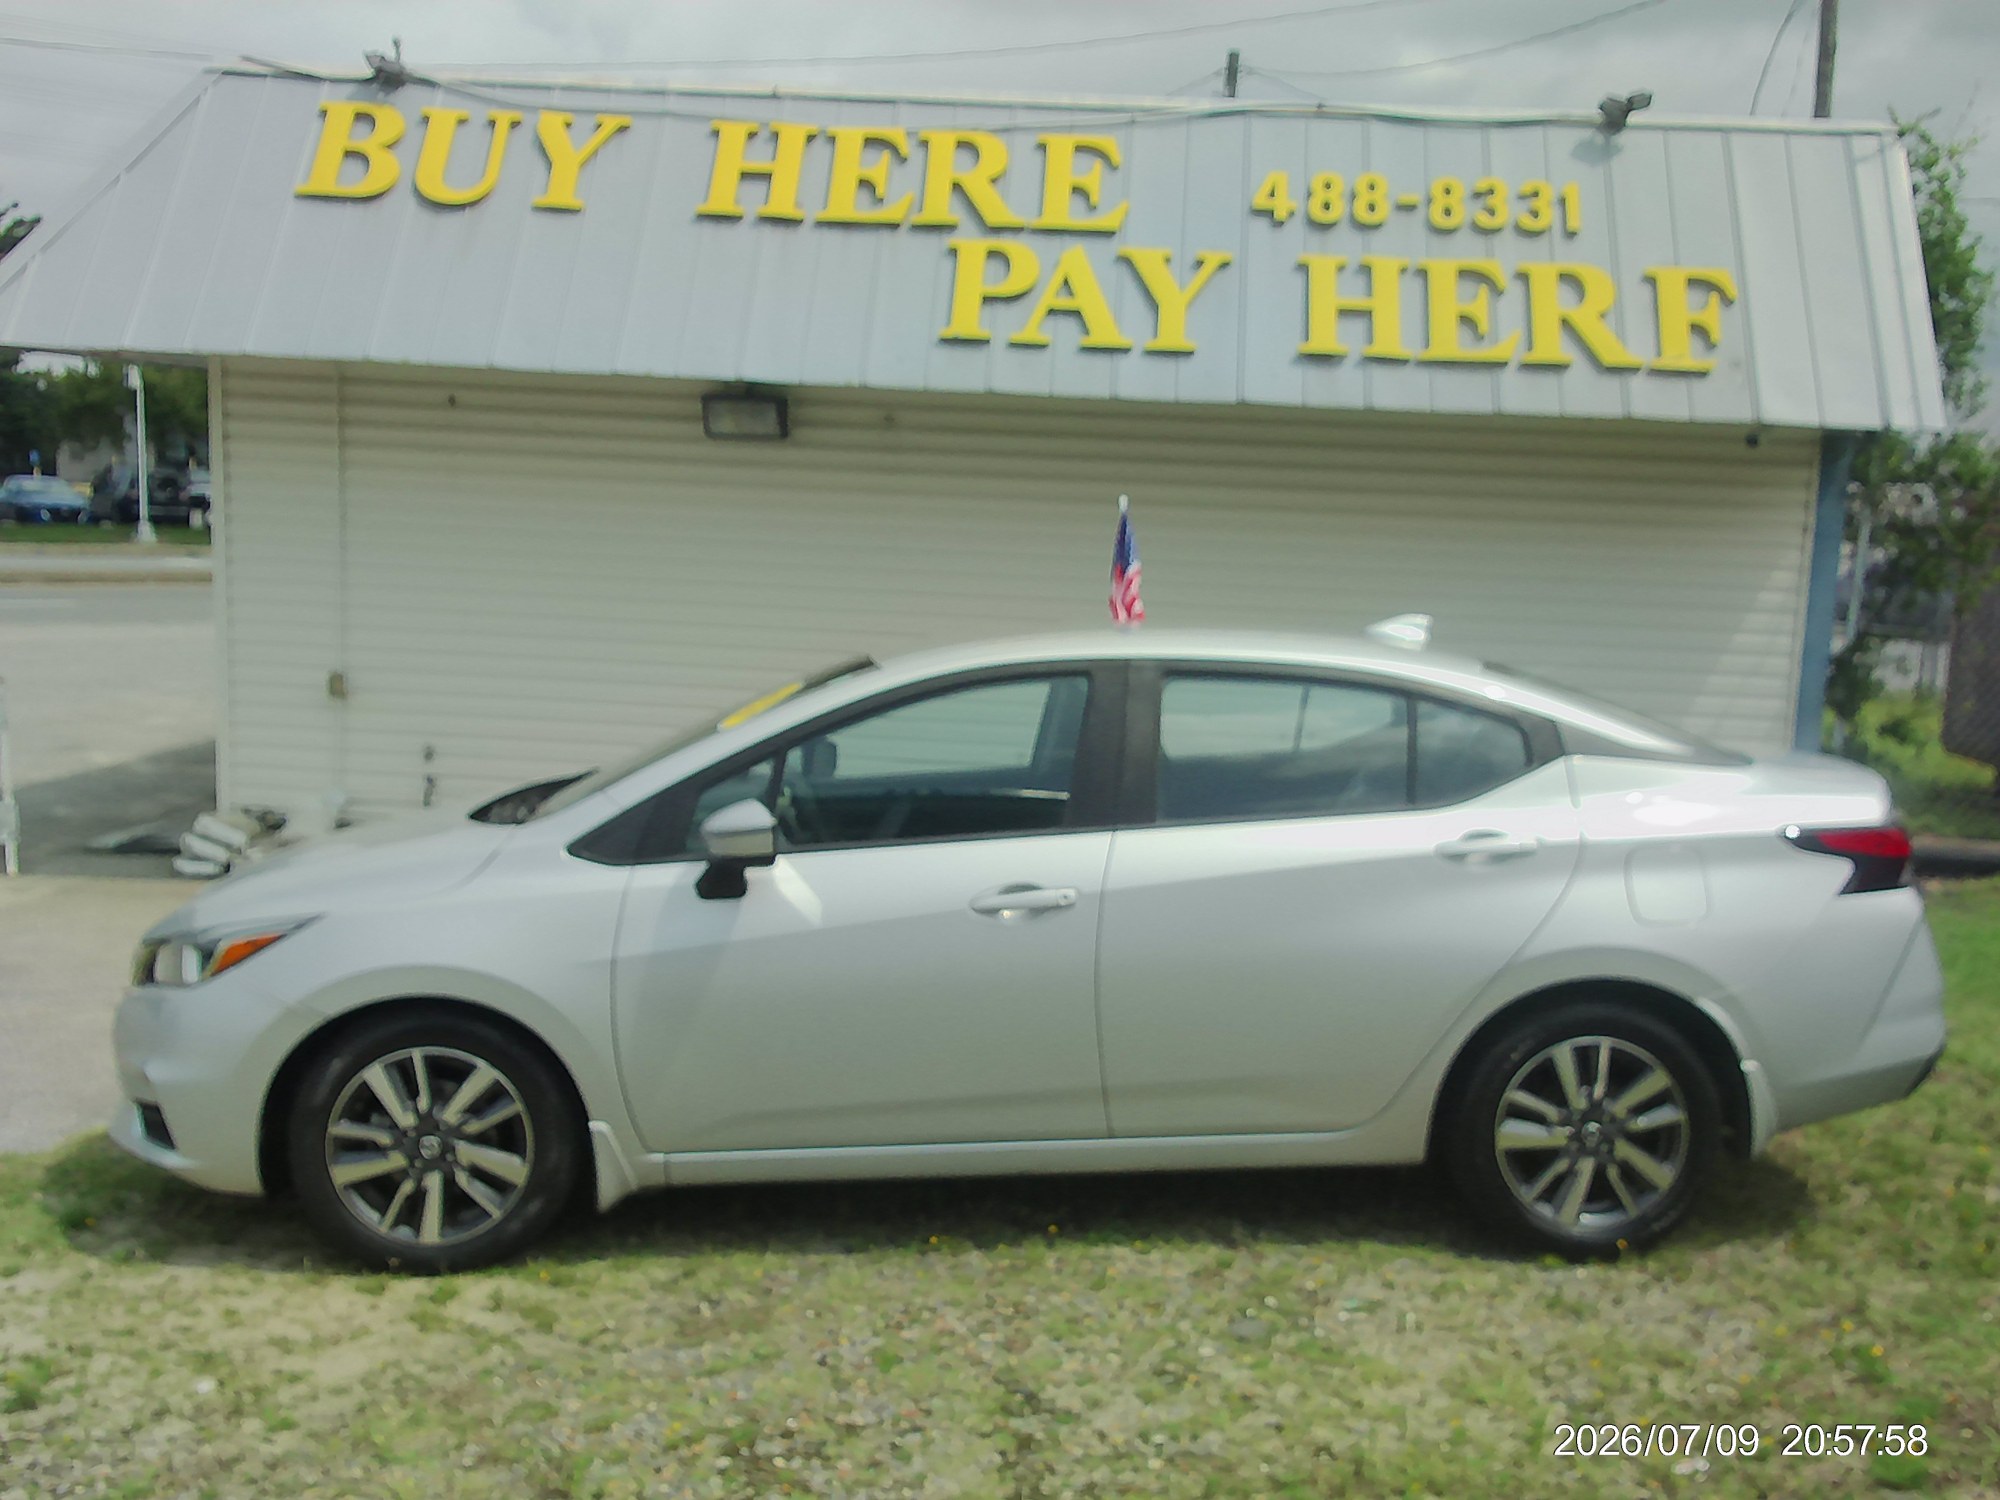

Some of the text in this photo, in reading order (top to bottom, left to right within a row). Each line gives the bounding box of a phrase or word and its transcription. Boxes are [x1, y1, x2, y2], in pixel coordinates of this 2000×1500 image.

[295, 100, 1130, 234] BUY HERE
[1252, 171, 1581, 236] 488-8331
[938, 238, 1233, 354] PAY
